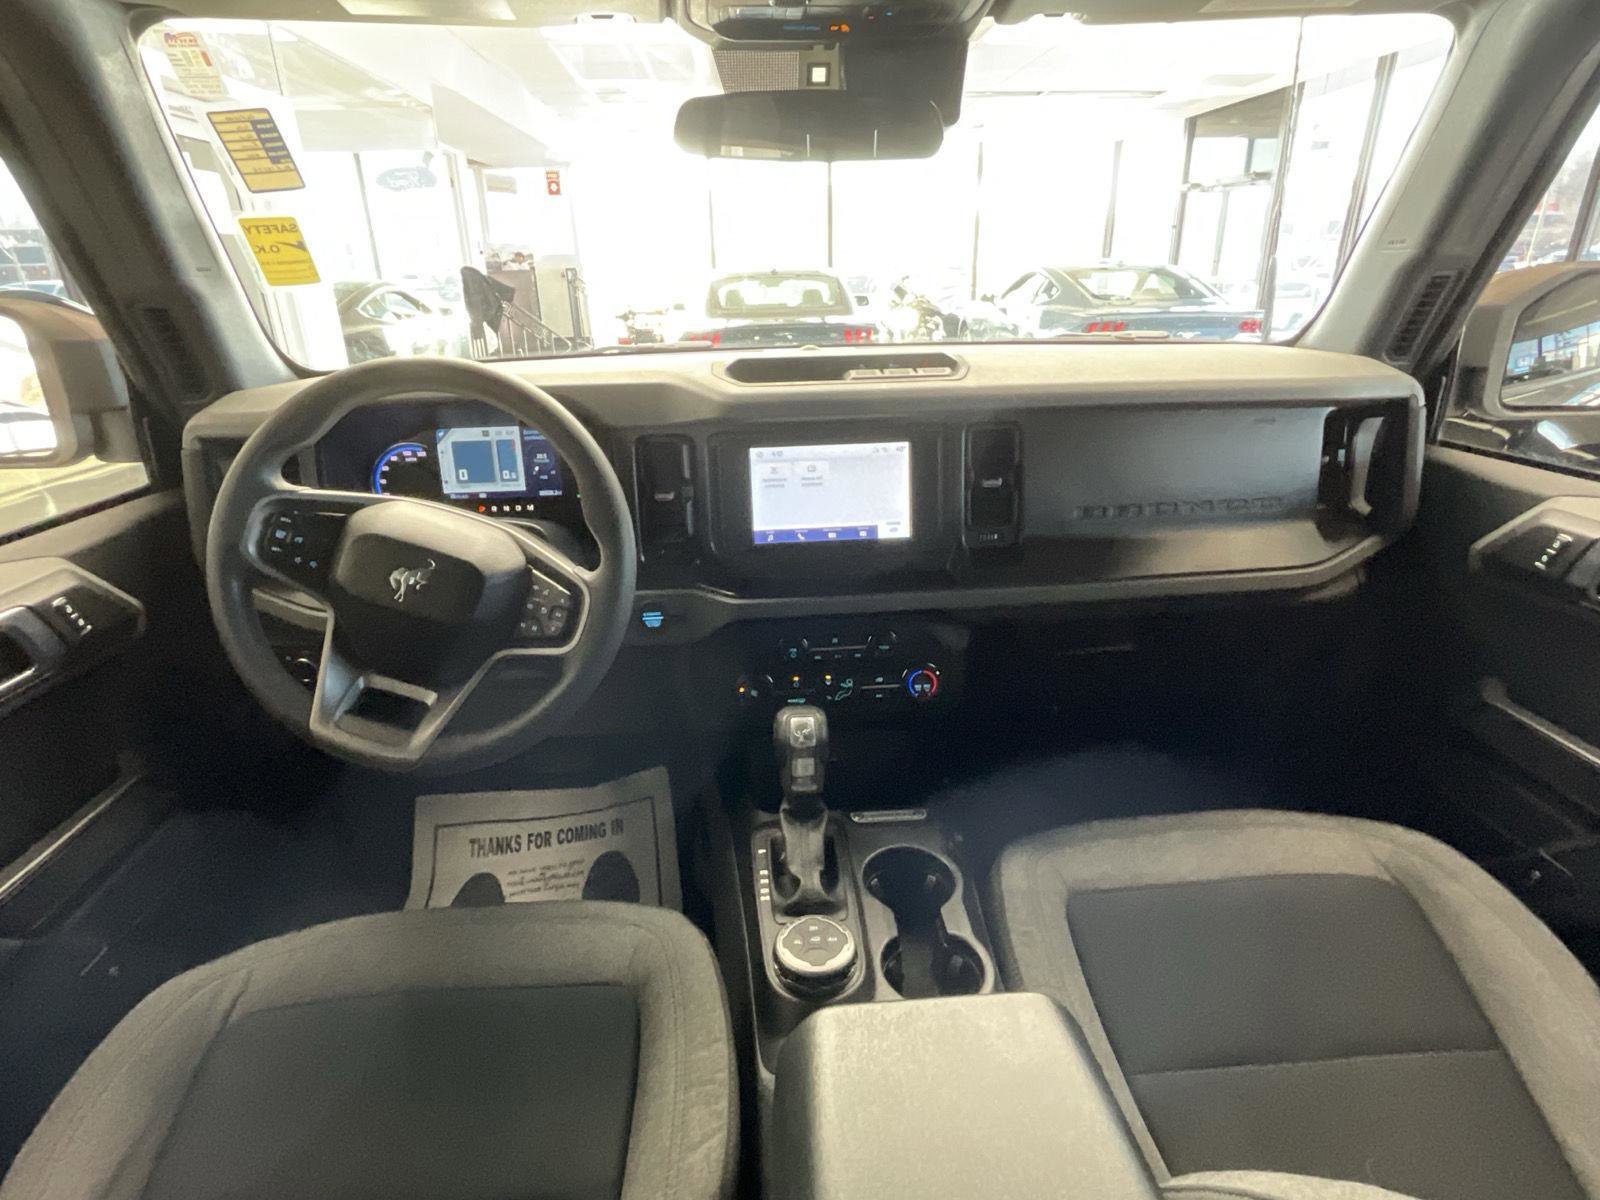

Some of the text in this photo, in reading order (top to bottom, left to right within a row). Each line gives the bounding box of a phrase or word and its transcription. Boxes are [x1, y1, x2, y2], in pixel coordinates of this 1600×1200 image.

[459, 469, 468, 481] 0
[469, 818, 624, 859] THANKS FOR COMING IN
